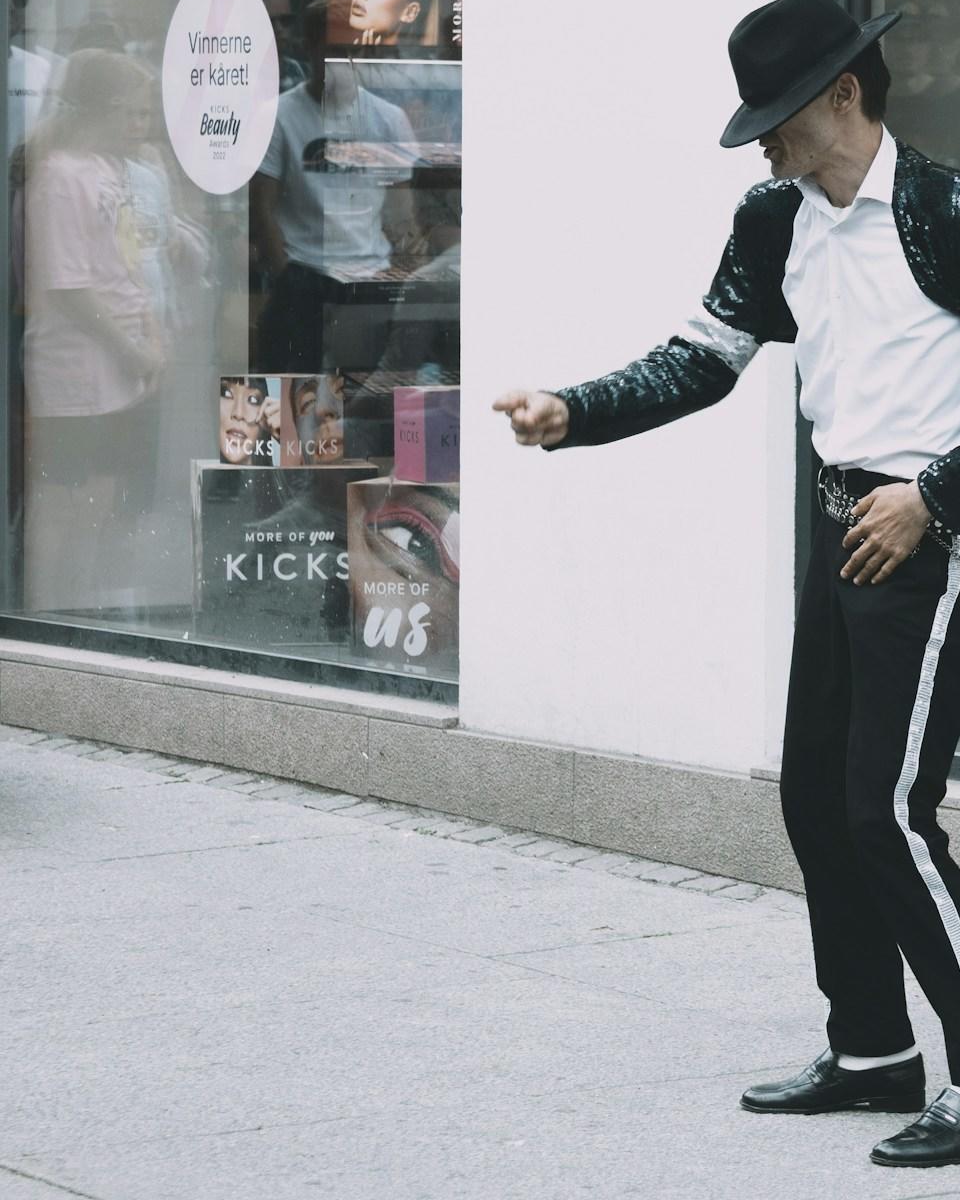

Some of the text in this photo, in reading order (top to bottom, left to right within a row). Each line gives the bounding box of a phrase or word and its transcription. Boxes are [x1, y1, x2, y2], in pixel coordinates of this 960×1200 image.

[188, 32, 252, 54] Vinnerne
[190, 63, 249, 86] er kåret!
[210, 105, 230, 114] KICKS
[200, 111, 241, 145] Beauty
[225, 439, 274, 457] KICKS
[286, 439, 338, 457] KICKS
[245, 531, 335, 547] MORE OF you
[226, 552, 349, 581] KICKS
[364, 581, 430, 597] MORE OF
[363, 602, 432, 657] us
